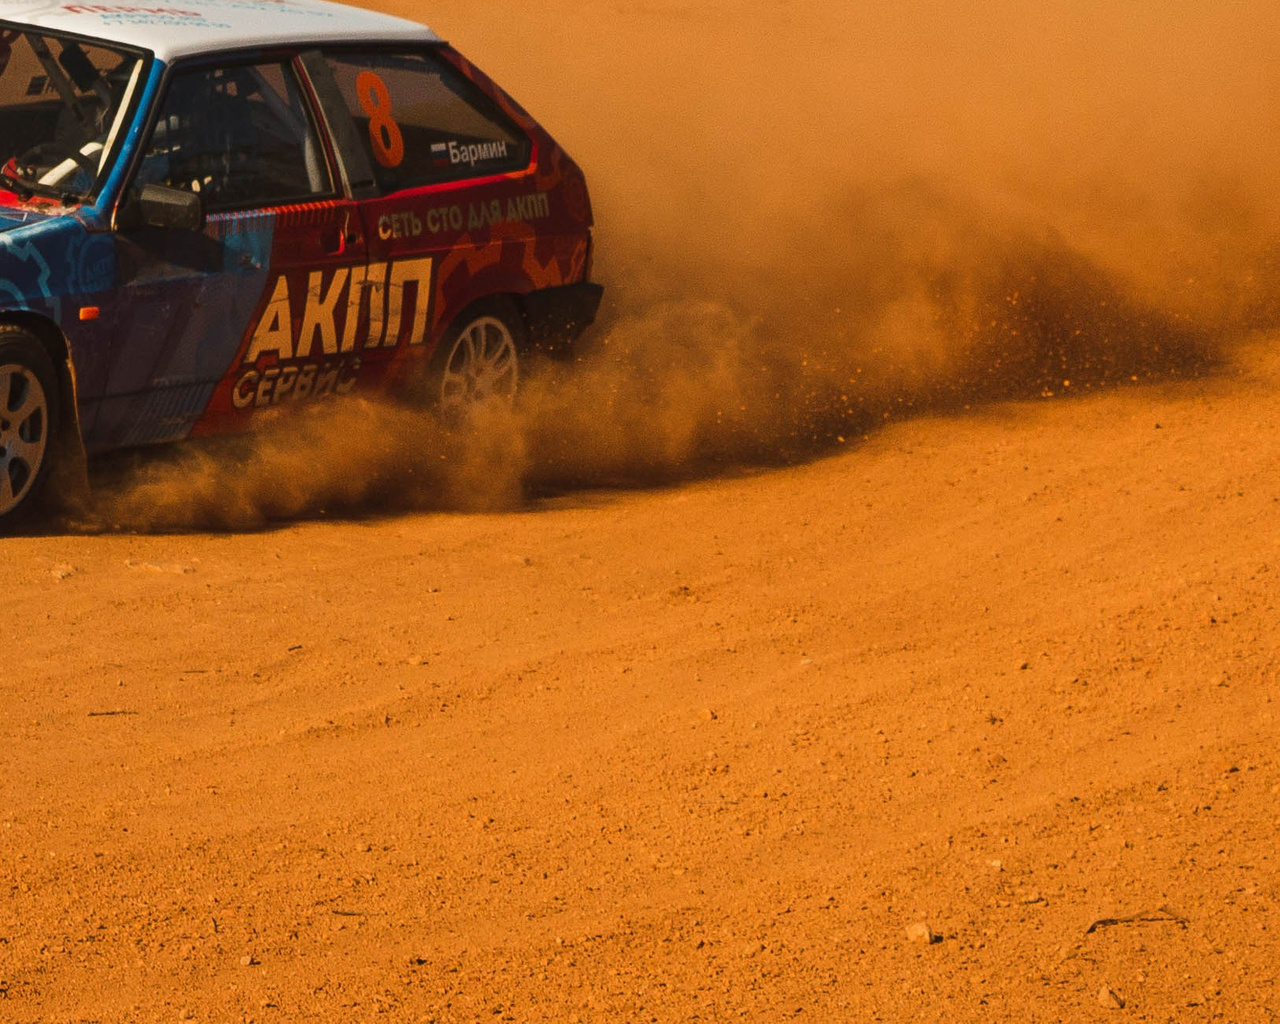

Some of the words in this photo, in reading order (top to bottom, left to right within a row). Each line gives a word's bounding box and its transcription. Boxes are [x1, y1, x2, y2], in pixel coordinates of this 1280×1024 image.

[356, 71, 404, 168] 8
[448, 141, 507, 166] Бармин
[378, 212, 421, 240] СЕТЬ
[427, 206, 463, 233] СТО
[468, 199, 502, 228] ДЛЯ
[507, 192, 550, 223] АКПП
[242, 257, 432, 364] АКПП
